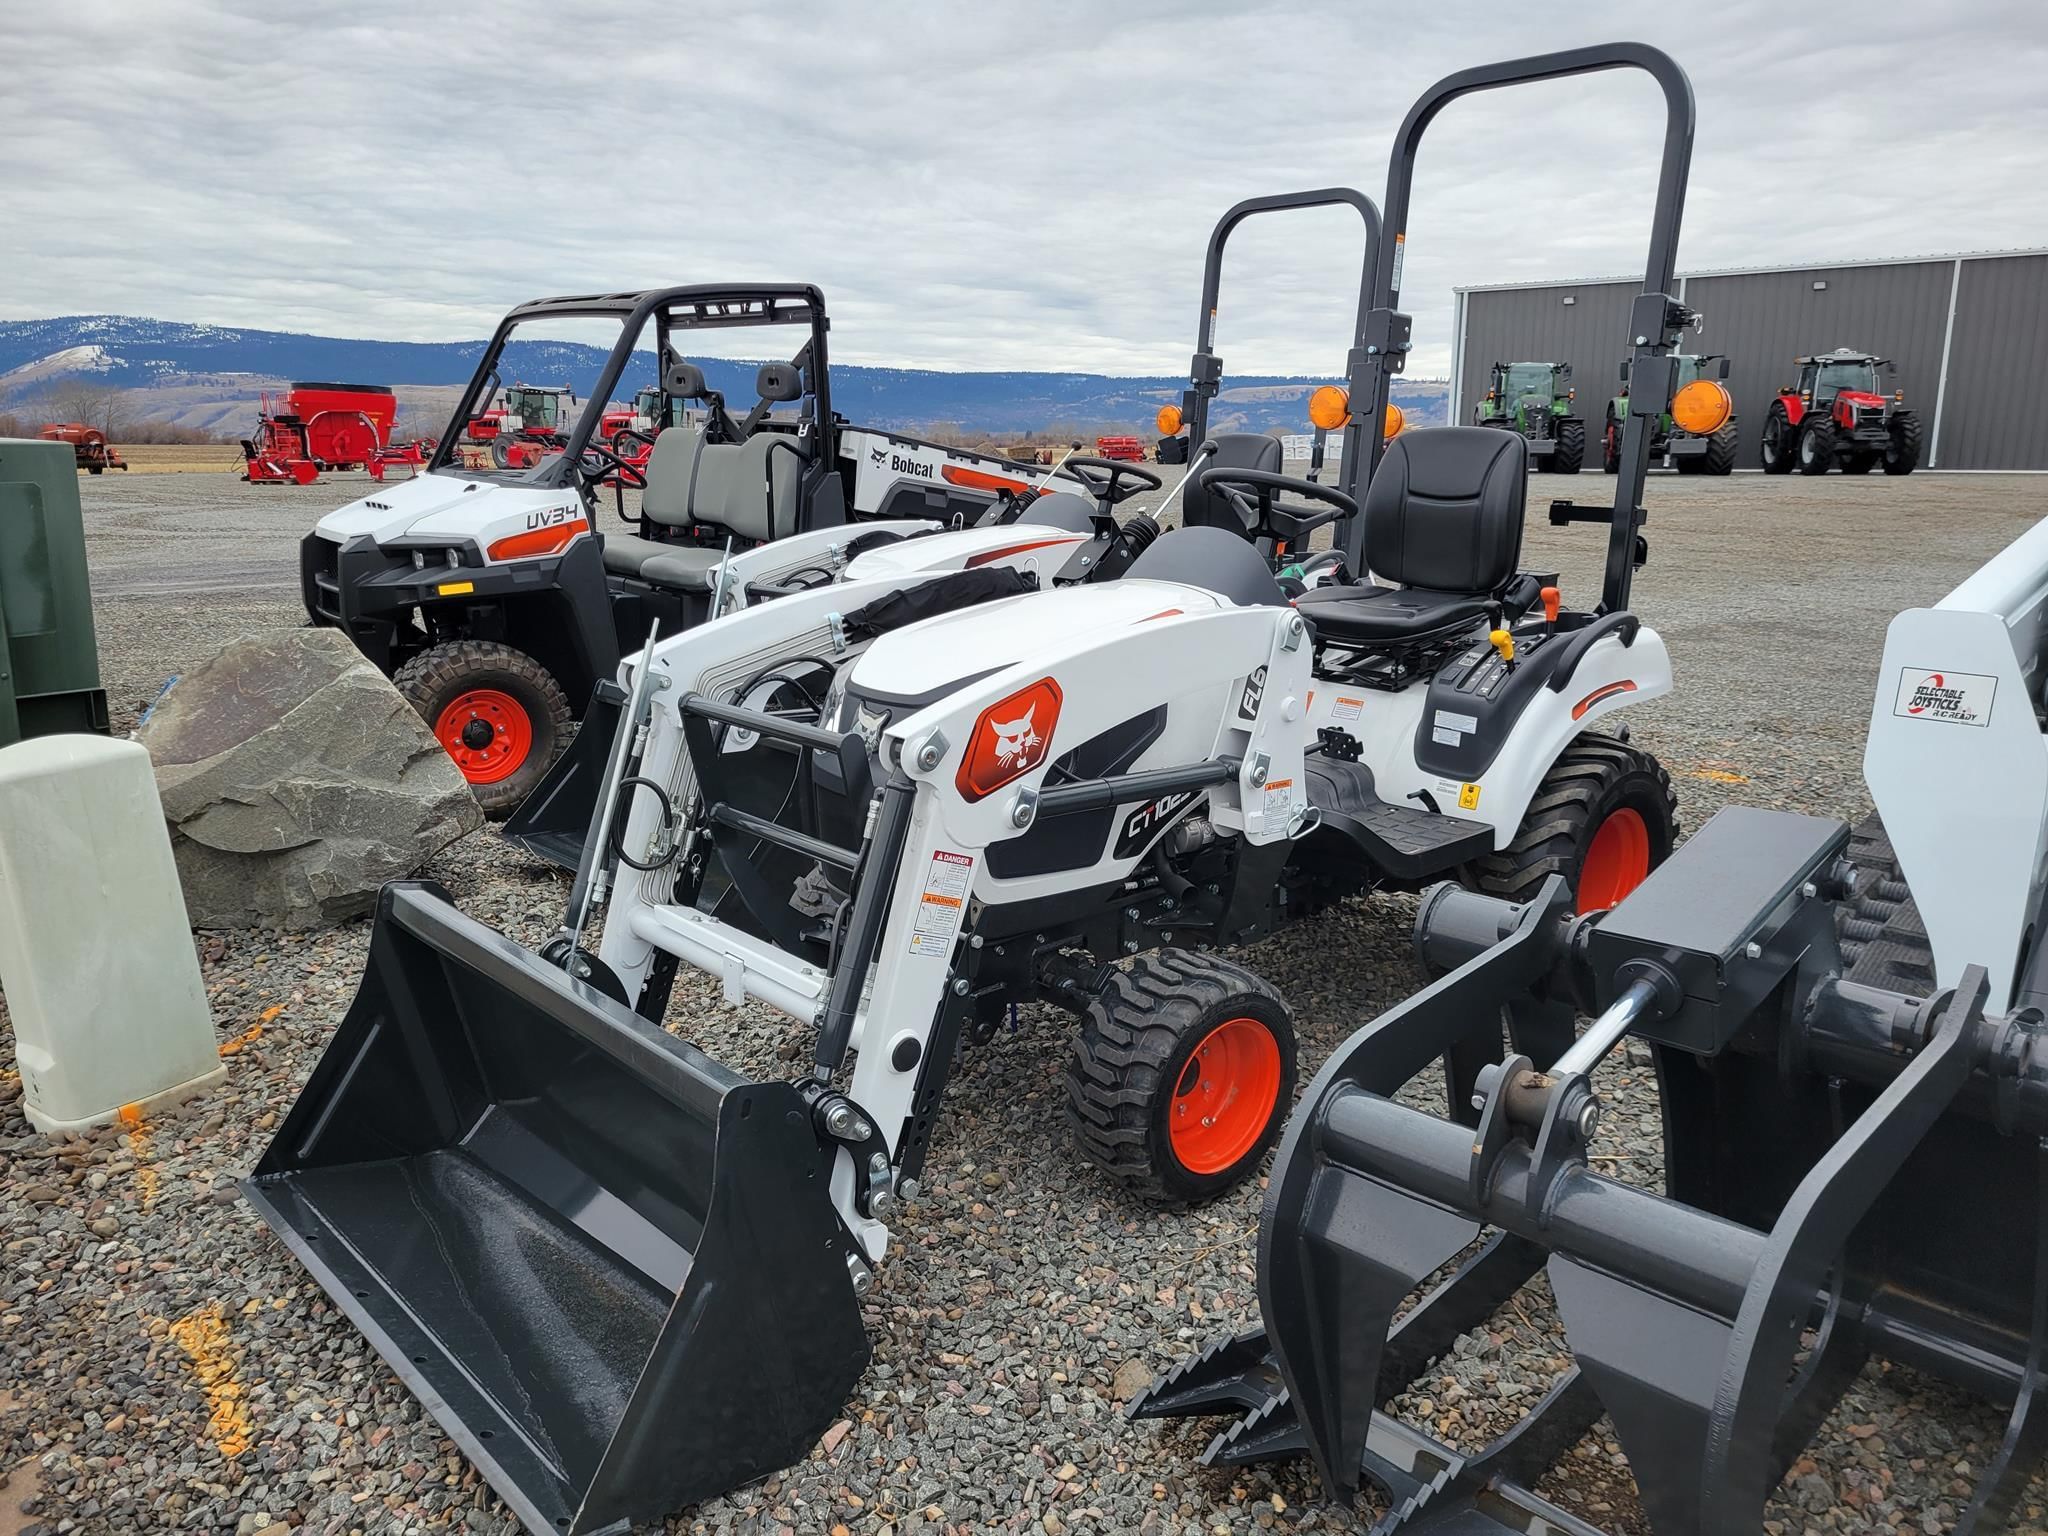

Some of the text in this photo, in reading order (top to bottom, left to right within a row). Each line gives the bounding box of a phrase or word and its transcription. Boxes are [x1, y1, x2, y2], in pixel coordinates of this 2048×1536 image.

[892, 455, 933, 478] Bobcat
[527, 504, 578, 529] UV34
[1243, 668, 1266, 716] FL6
[1915, 686, 1965, 699] SELECTABLE
[1909, 695, 1960, 710] JOYSTICKS
[1949, 711, 1977, 721] READY
[943, 854, 970, 866] DANGER
[931, 896, 958, 906] WARNING
